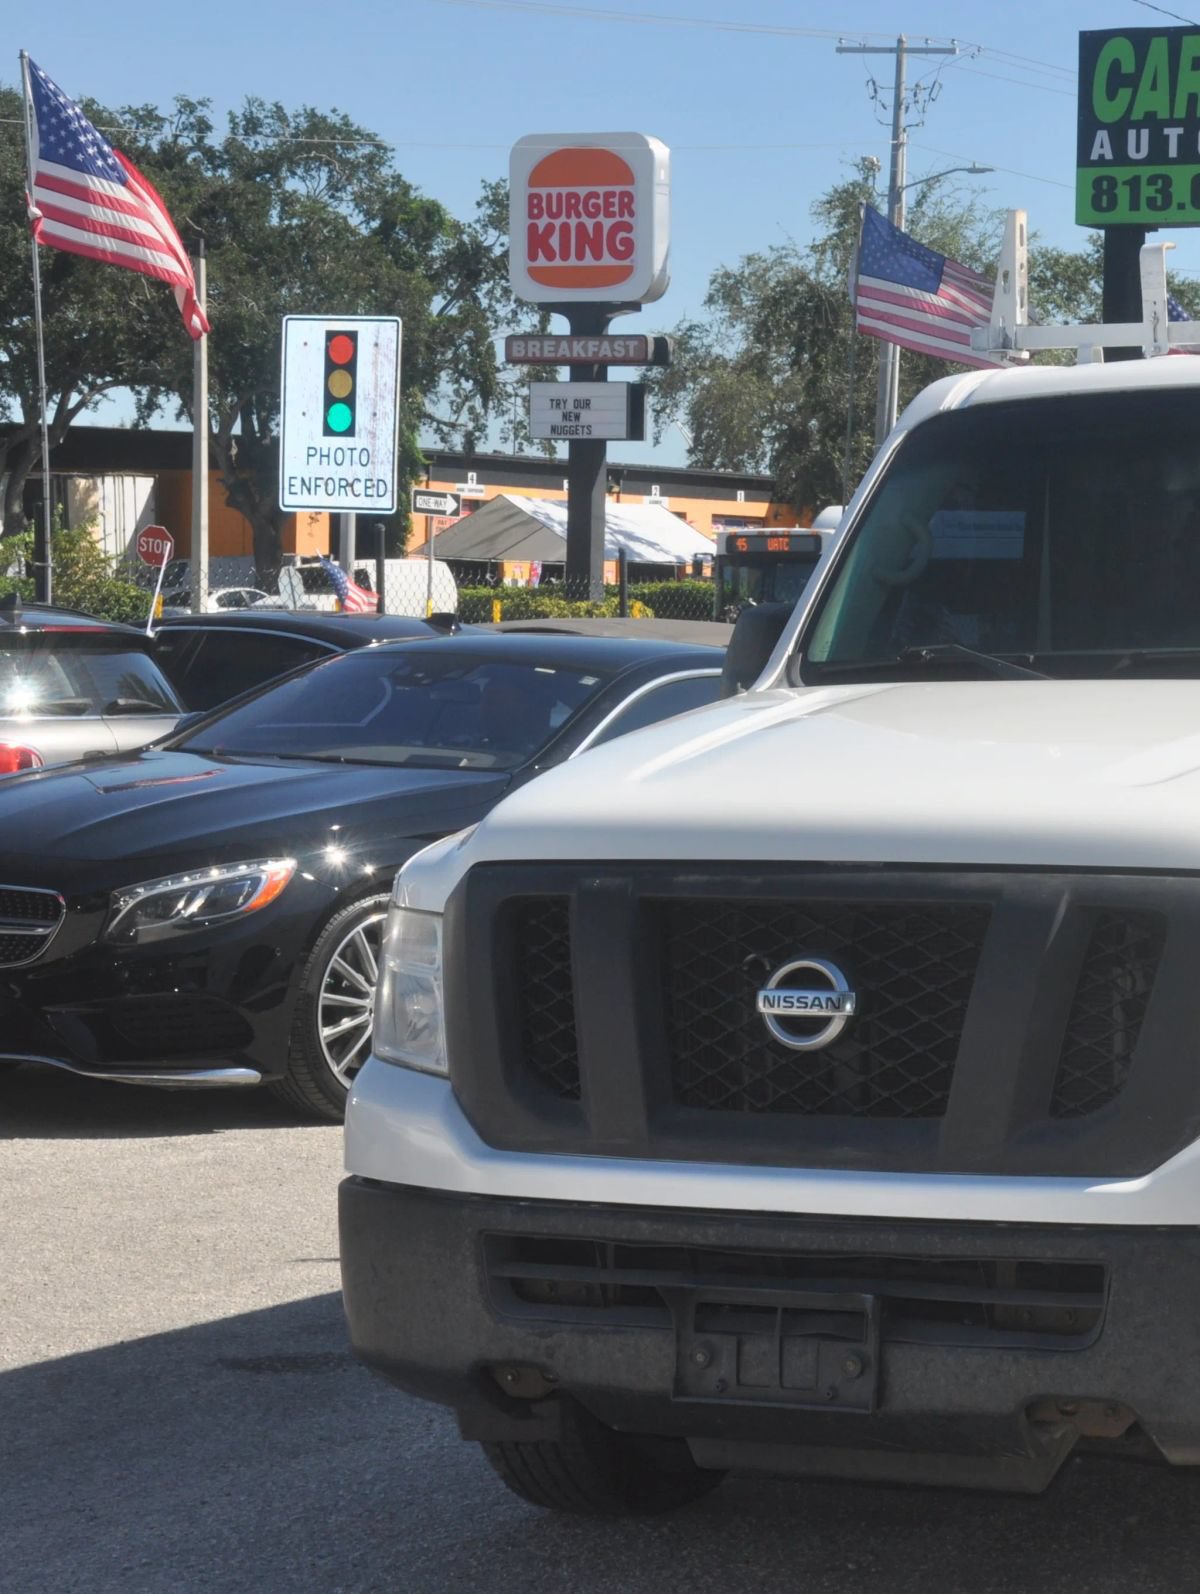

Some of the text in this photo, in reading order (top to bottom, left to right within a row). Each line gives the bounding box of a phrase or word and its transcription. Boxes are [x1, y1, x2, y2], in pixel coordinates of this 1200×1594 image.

[527, 190, 635, 220] BURGER
[527, 220, 635, 262] KING
[511, 340, 639, 358] BREAKFAST
[550, 398, 591, 410] TRY OUR
[562, 411, 581, 422] NEW
[550, 424, 592, 436] NUGGETS
[306, 446, 370, 467] PHOTO
[288, 476, 388, 498] ENFORCED
[418, 496, 447, 509] ONE WAY
[763, 994, 841, 1010] NISSAN
